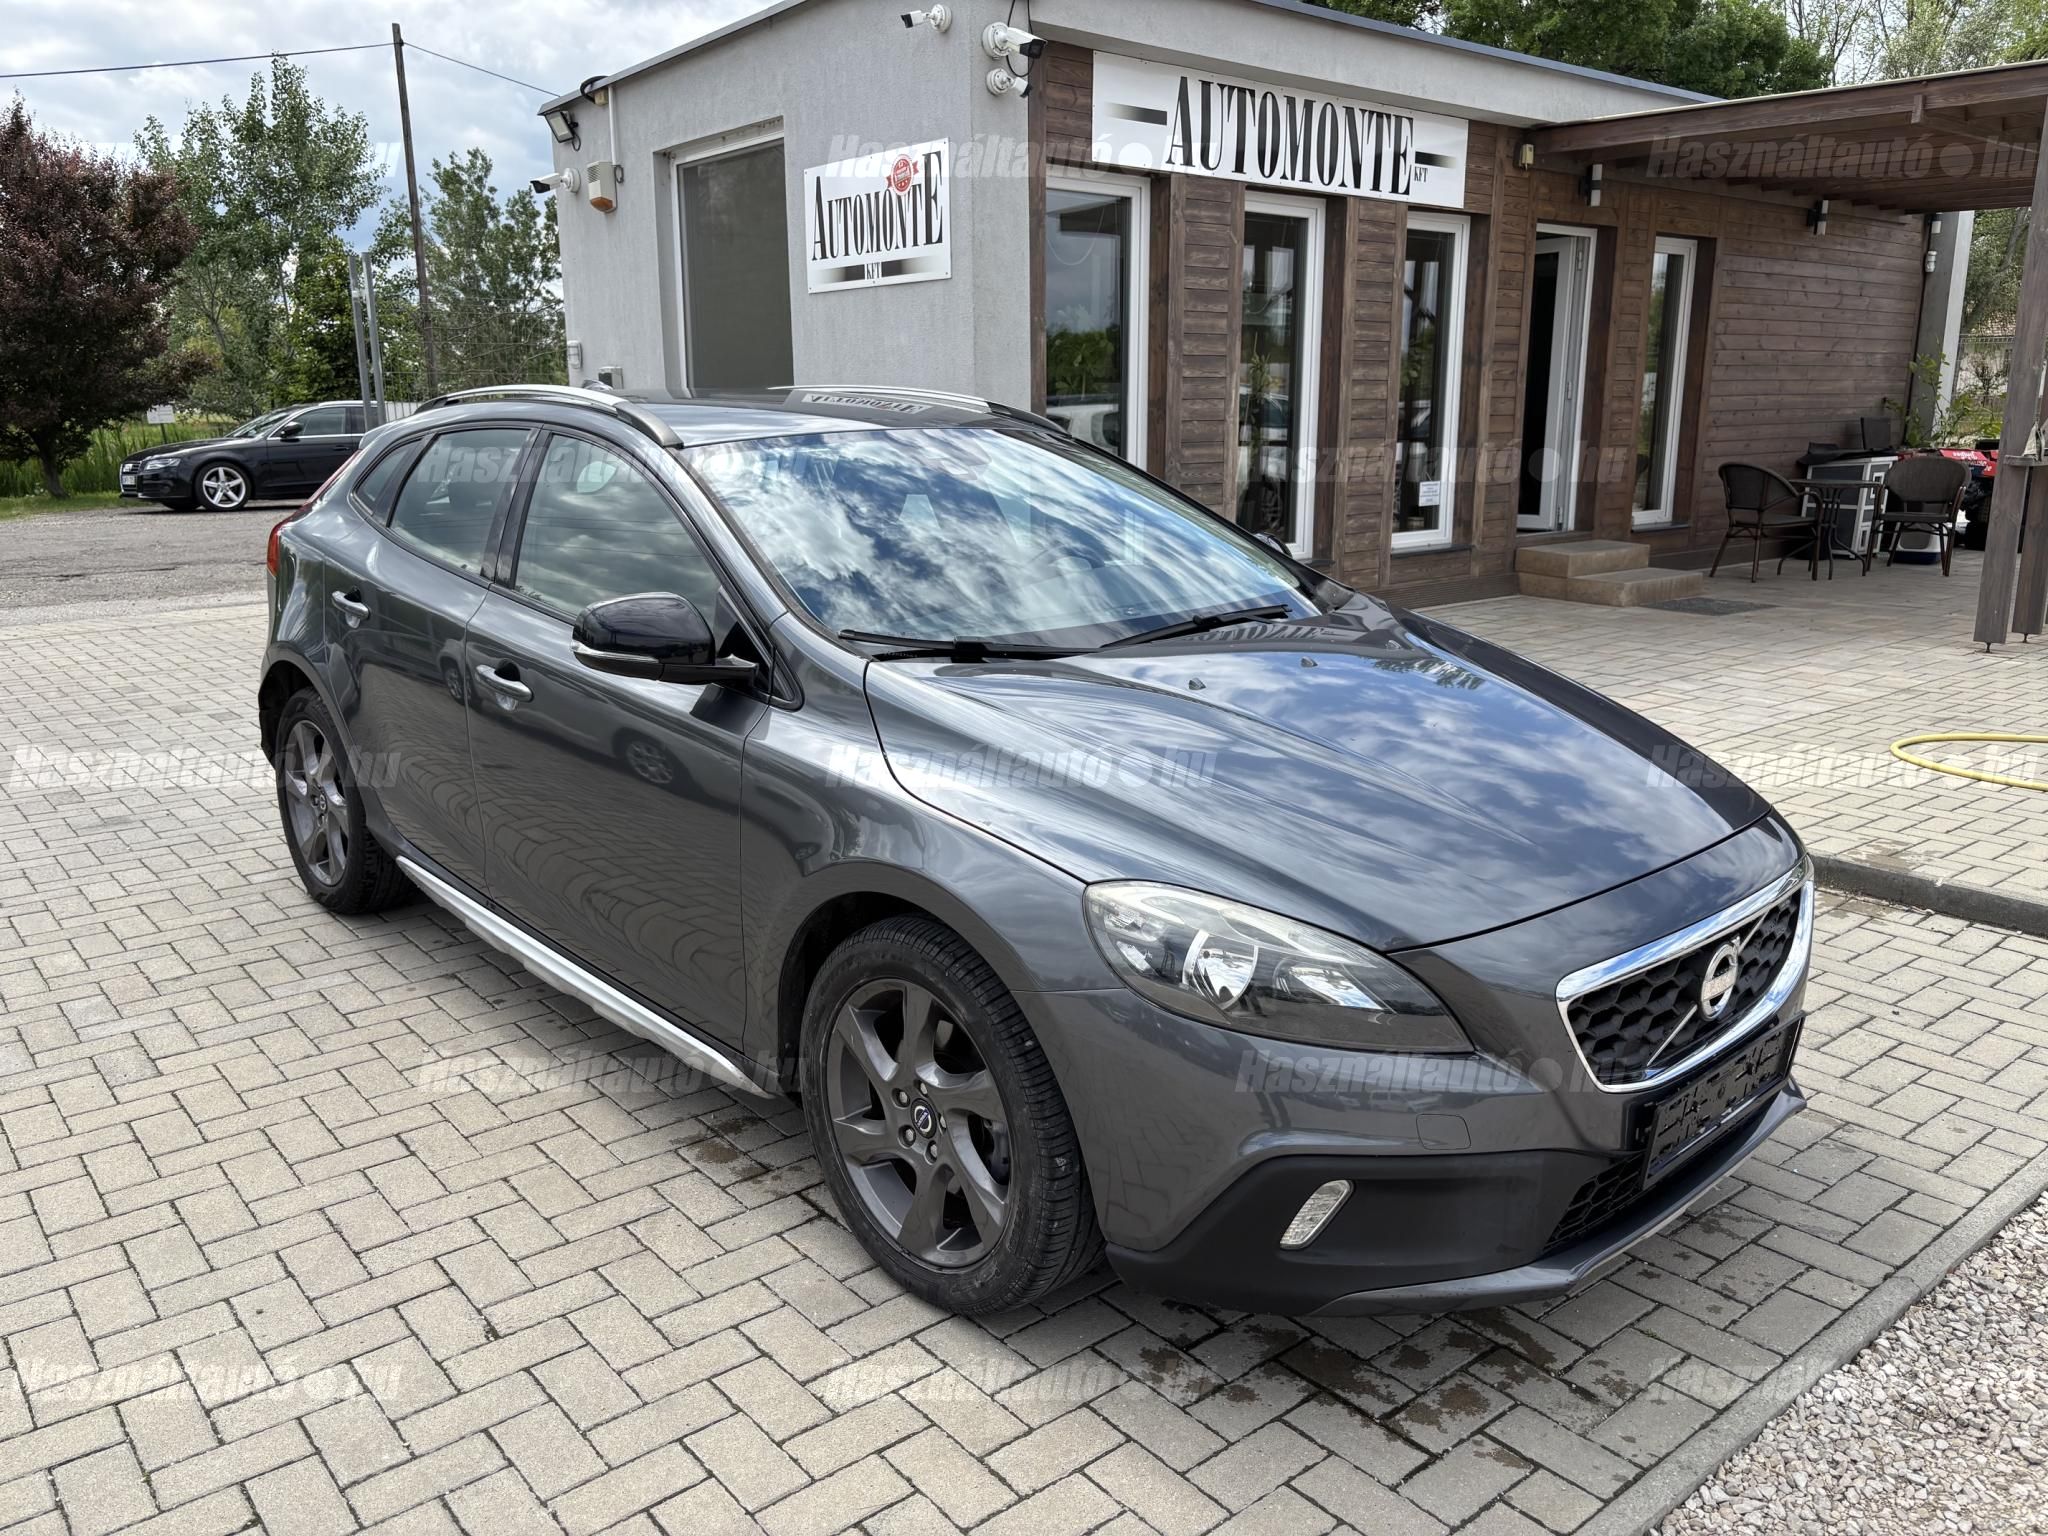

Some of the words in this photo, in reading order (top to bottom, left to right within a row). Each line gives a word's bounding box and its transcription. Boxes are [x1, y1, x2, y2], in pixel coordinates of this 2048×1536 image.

[1165, 76, 1415, 196] AUTOMONTE
[811, 151, 943, 261] AUTOMONTE
[1413, 167, 1429, 183] KFT
[866, 261, 881, 280] KFT
